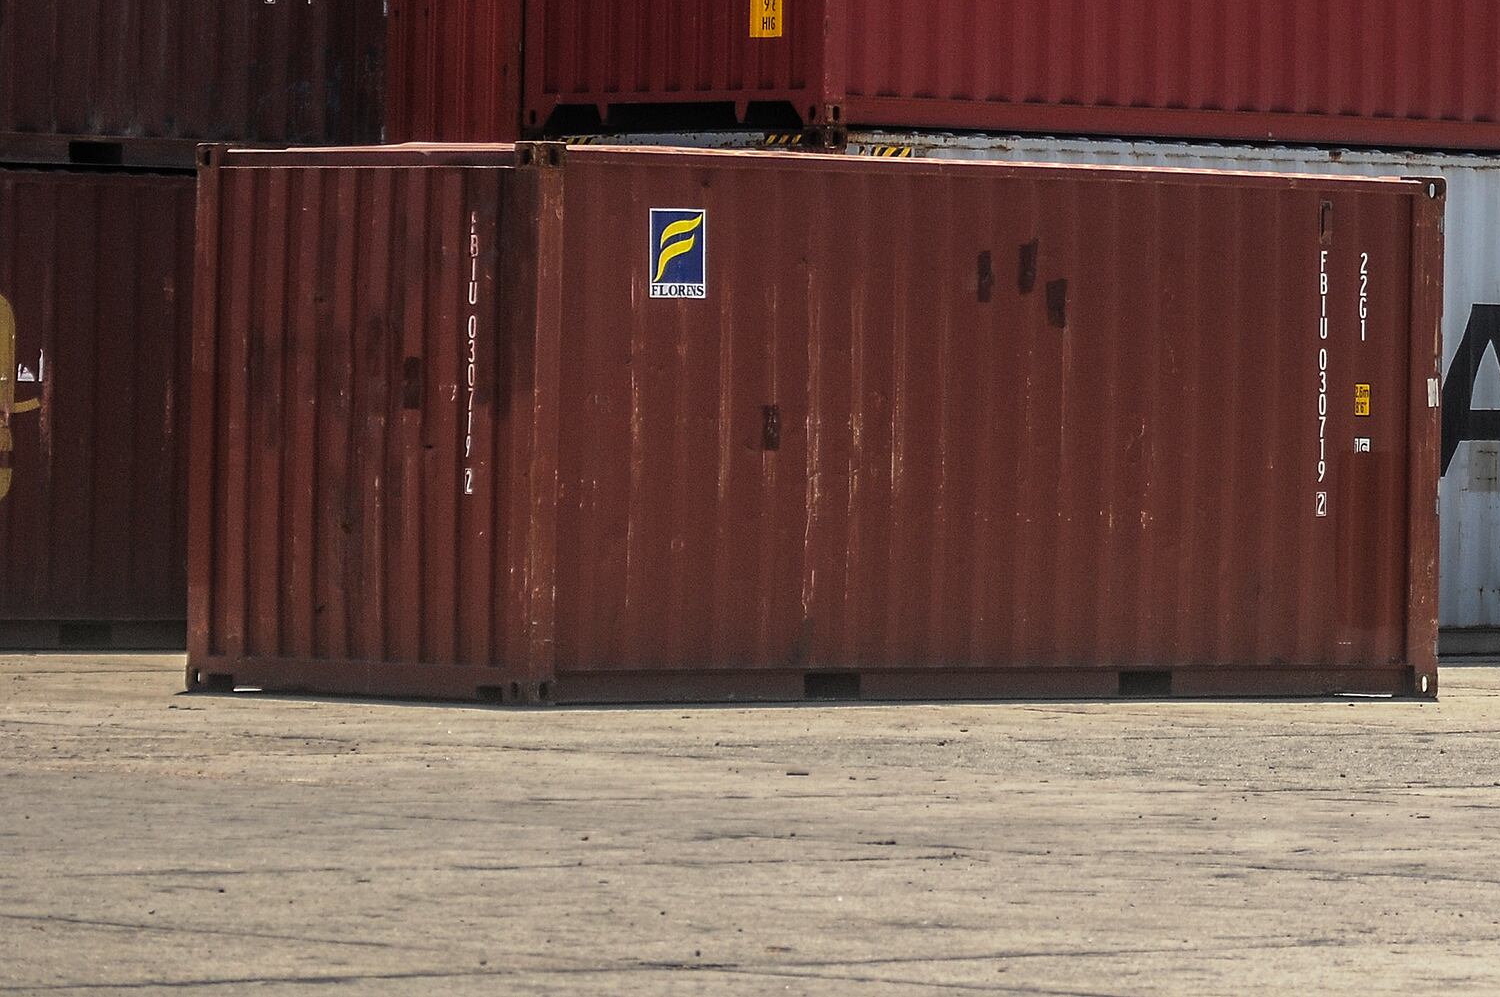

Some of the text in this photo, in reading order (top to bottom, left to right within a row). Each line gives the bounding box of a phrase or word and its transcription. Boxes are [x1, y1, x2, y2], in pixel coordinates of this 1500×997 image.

[651, 284, 704, 296] FLORENS
[1359, 252, 1368, 341] 22G1
[465, 315, 477, 457] 030719
[1316, 251, 1328, 516] FBIU 030719 2
[464, 468, 473, 494] 2
